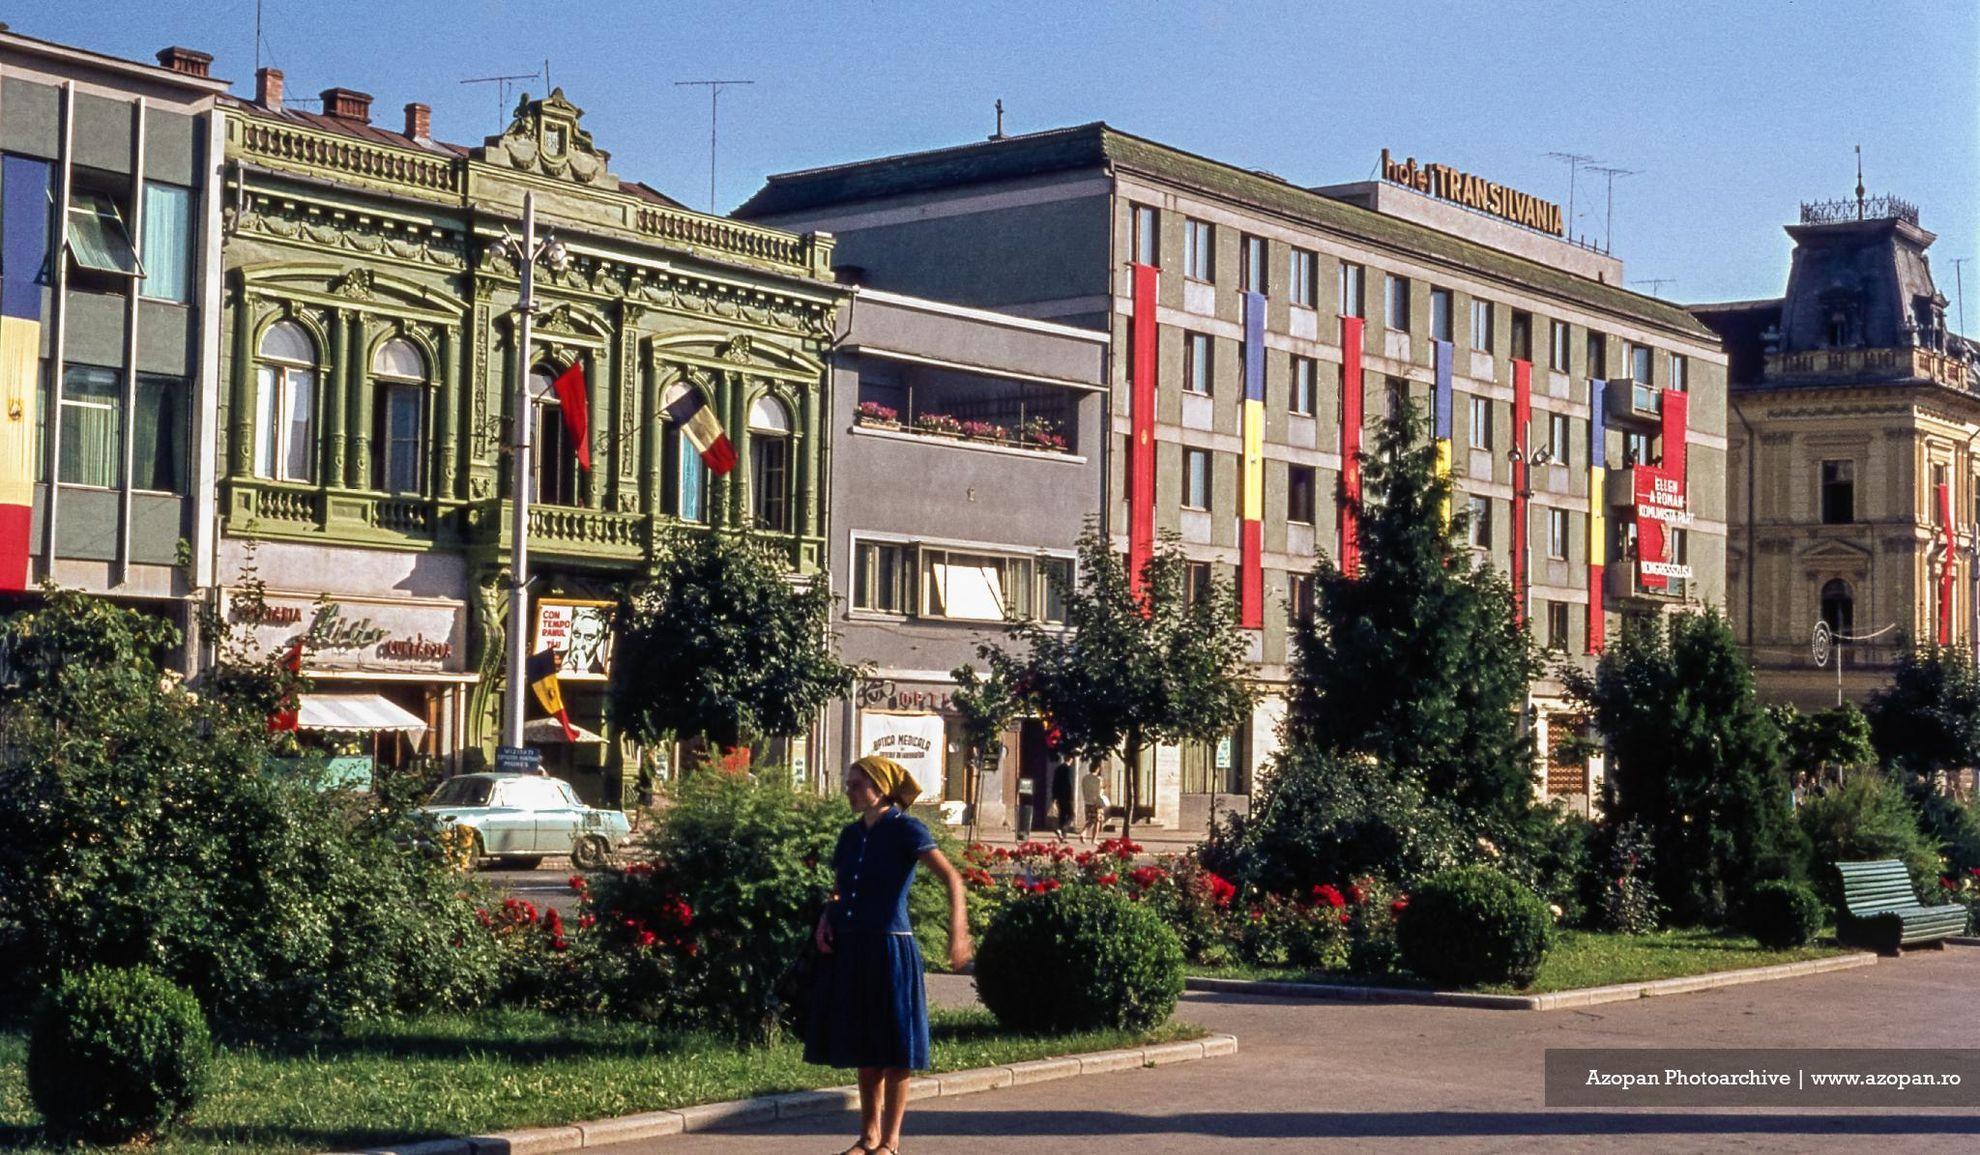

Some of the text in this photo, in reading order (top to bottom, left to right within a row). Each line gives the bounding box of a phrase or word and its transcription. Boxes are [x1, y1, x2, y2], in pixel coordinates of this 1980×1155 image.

[1381, 148, 1565, 237] hotel TRANSILVANIA
[543, 610, 560, 619] CON
[543, 620, 570, 628] TEMPO
